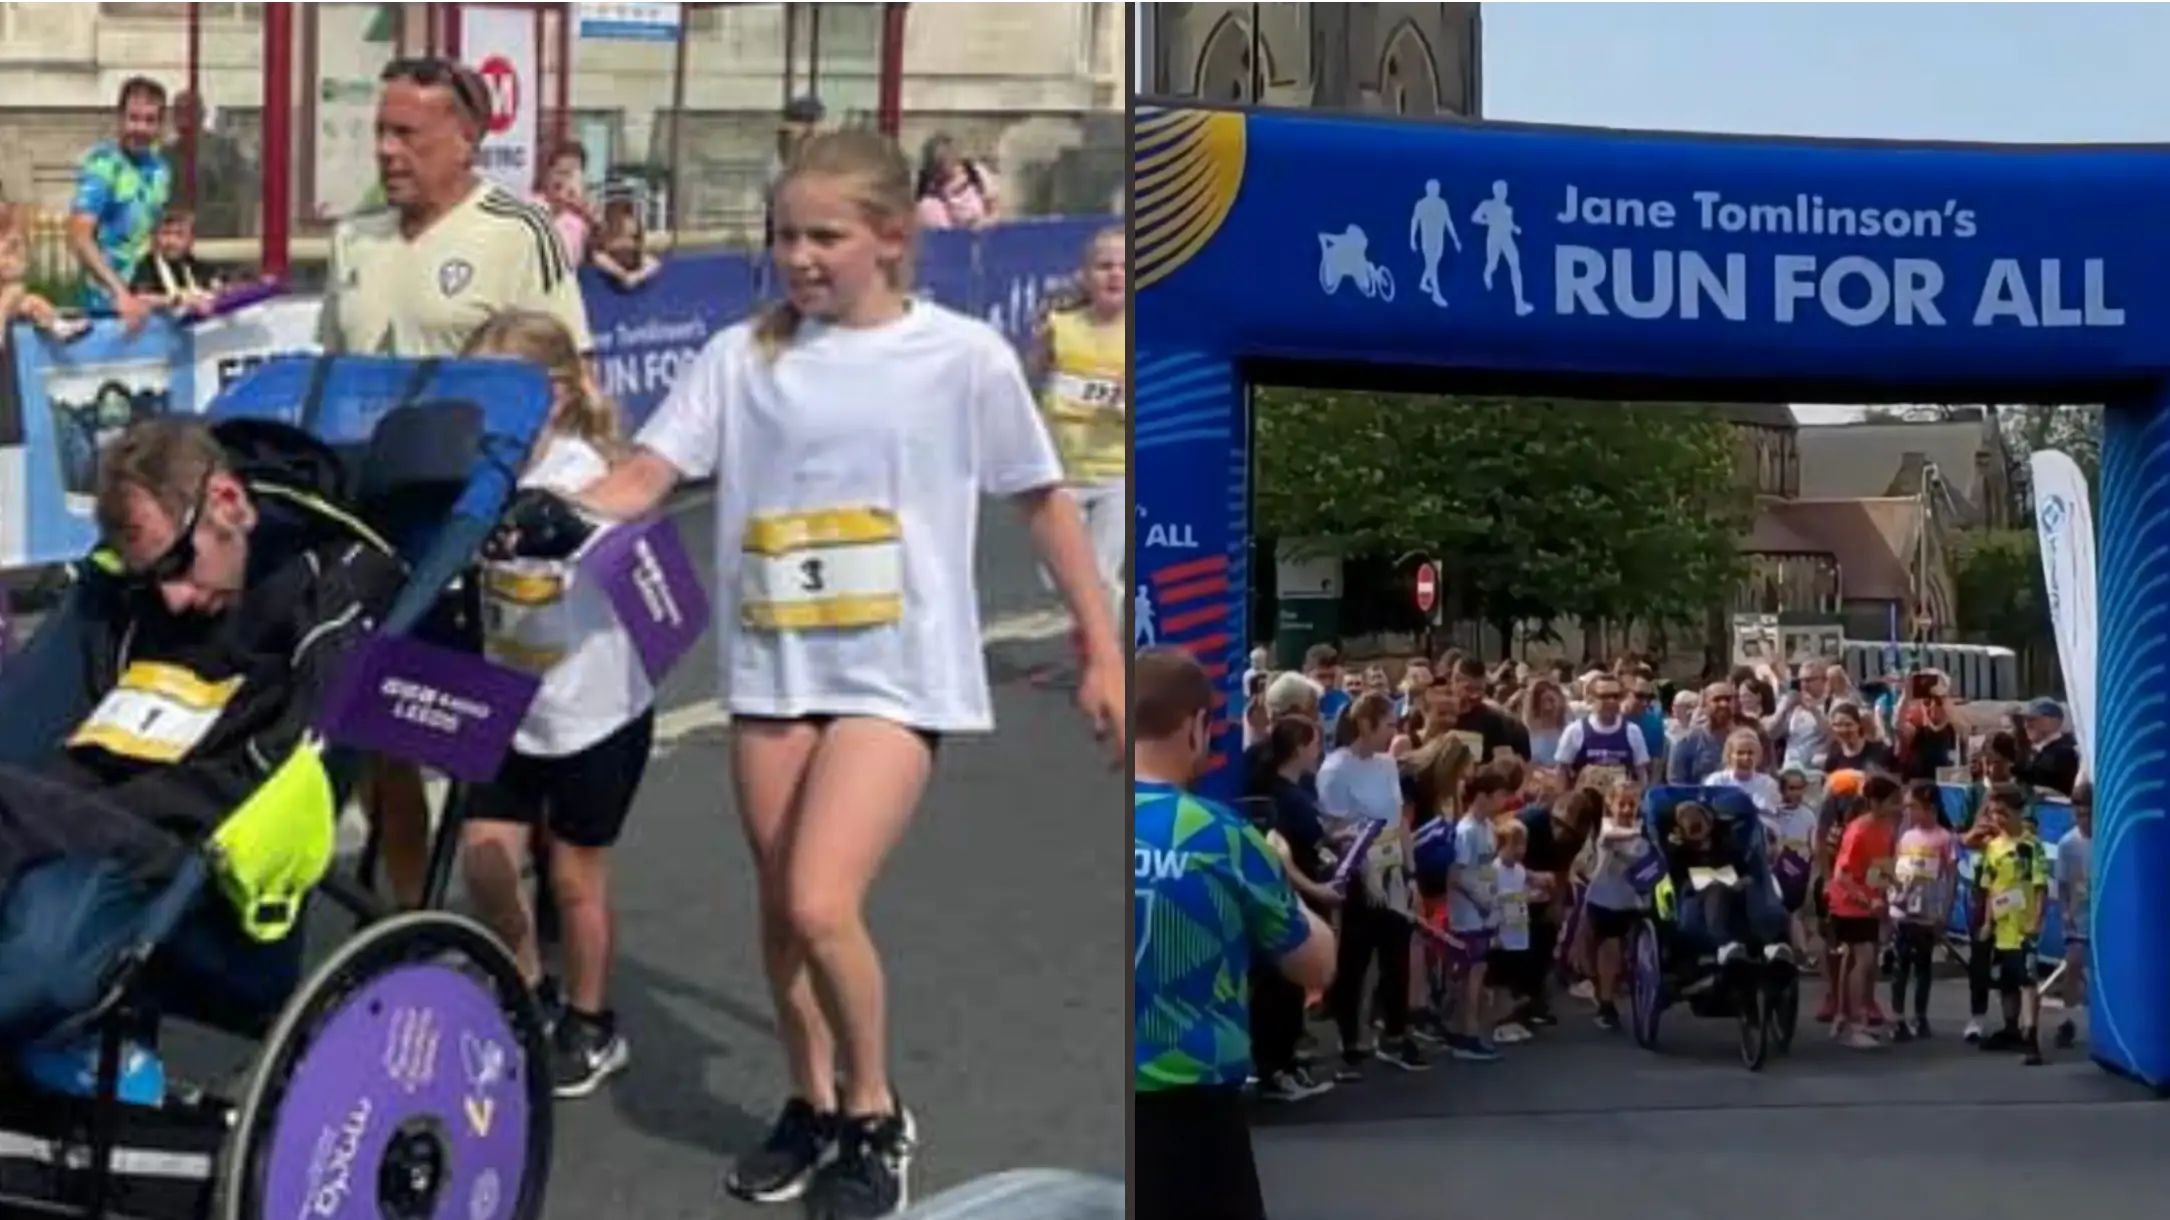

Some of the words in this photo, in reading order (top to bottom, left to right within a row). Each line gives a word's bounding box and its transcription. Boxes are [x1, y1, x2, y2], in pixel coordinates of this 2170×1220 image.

[1556, 184, 1676, 228] Jane
[1693, 191, 1977, 237] Tomlinson's
[1556, 244, 1746, 320] RUN
[1774, 254, 1946, 326] FOR
[1972, 258, 2125, 327] ALL
[1145, 523, 1199, 549] ALL
[799, 557, 825, 590] 3
[140, 707, 164, 732] 1
